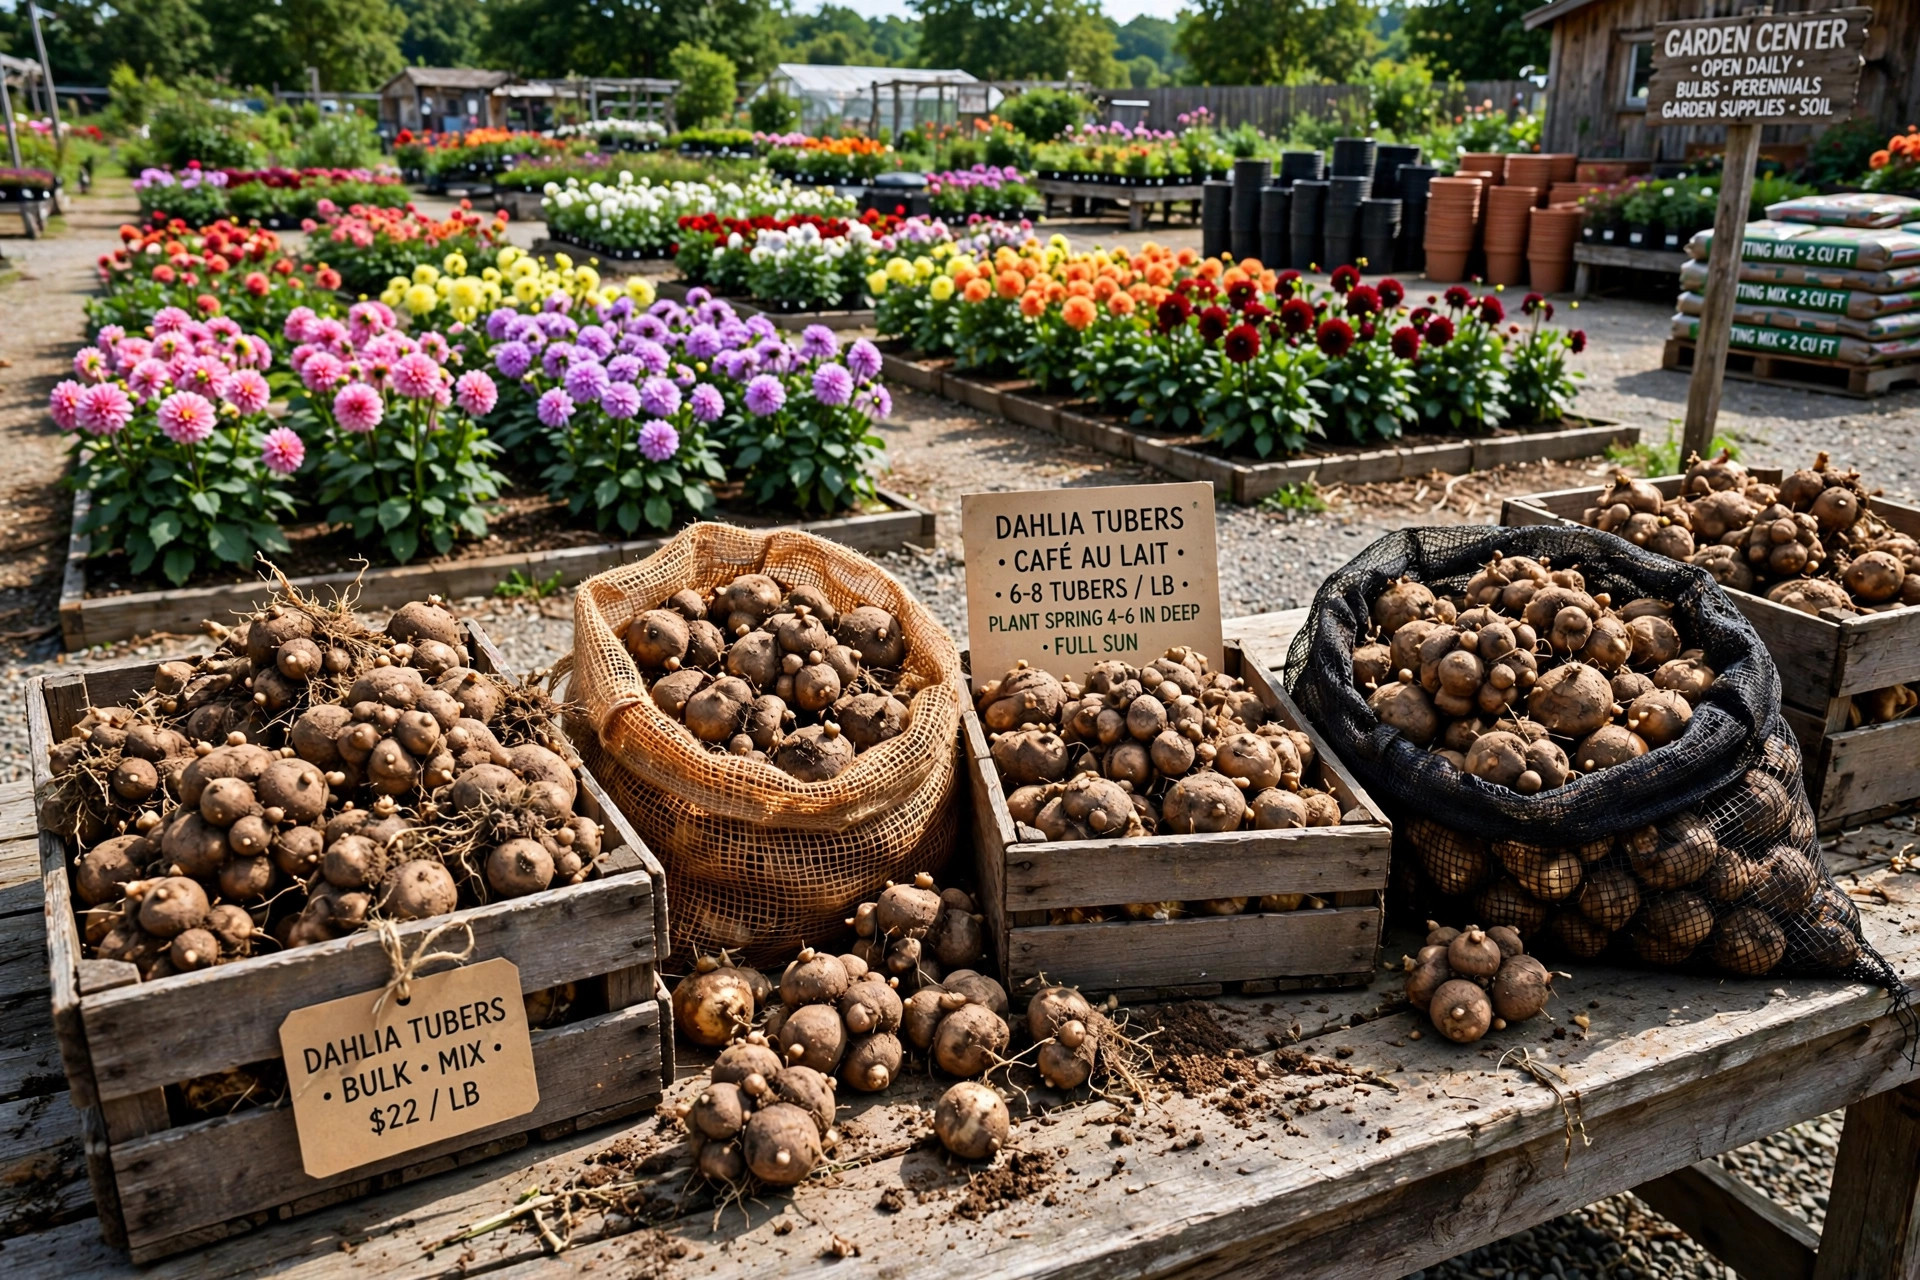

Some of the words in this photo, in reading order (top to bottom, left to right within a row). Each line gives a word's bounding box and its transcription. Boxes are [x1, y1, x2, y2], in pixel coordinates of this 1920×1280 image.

[1664, 25, 1751, 57] GARDEN
[1756, 19, 1848, 52] CENTER
[1701, 58, 1741, 77] OPEN
[1746, 55, 1793, 74] DAILY
[1676, 80, 1720, 98] BULBS
[1732, 77, 1822, 96] PERENNIALS
[1662, 100, 1715, 118] GARDEN
[1720, 98, 1785, 117] SUPPLIES
[1799, 98, 1833, 116] SOIL
[1774, 244, 1796, 258] MIX
[1806, 246, 1816, 259] 2
[1817, 246, 1833, 262] CU
[1837, 248, 1854, 263] FT
[1767, 286, 1788, 302] MIX
[1798, 290, 1807, 305] 2
[1809, 291, 1825, 306] CU
[1829, 293, 1845, 308] FT
[1757, 331, 1779, 347] MIX
[1789, 335, 1798, 349] 2
[1800, 337, 1817, 352] CU
[1819, 339, 1835, 354] FT
[996, 511, 1084, 539] DAHLIA
[1092, 507, 1184, 533] TUBERS
[1014, 542, 1072, 572] CAFÉ
[1081, 546, 1111, 569] AU
[1120, 542, 1169, 567] LAIT
[1010, 583, 1043, 604] 6-8
[1050, 578, 1127, 602] TUBERS
[1151, 575, 1174, 596] LB
[989, 613, 1040, 632] PLANT
[1045, 609, 1102, 629] SPRING
[1107, 608, 1135, 625] 4-6
[1140, 606, 1155, 623] IN
[1161, 604, 1200, 622] DEEP
[1054, 636, 1097, 655] FULL
[1103, 633, 1138, 652] SUN
[303, 1025, 402, 1075] DAHLIA
[407, 997, 506, 1044] TUBERS
[342, 1060, 412, 1104] BULK
[438, 1040, 485, 1075] MIX
[370, 1099, 420, 1136] $22
[449, 1081, 480, 1112] LB
